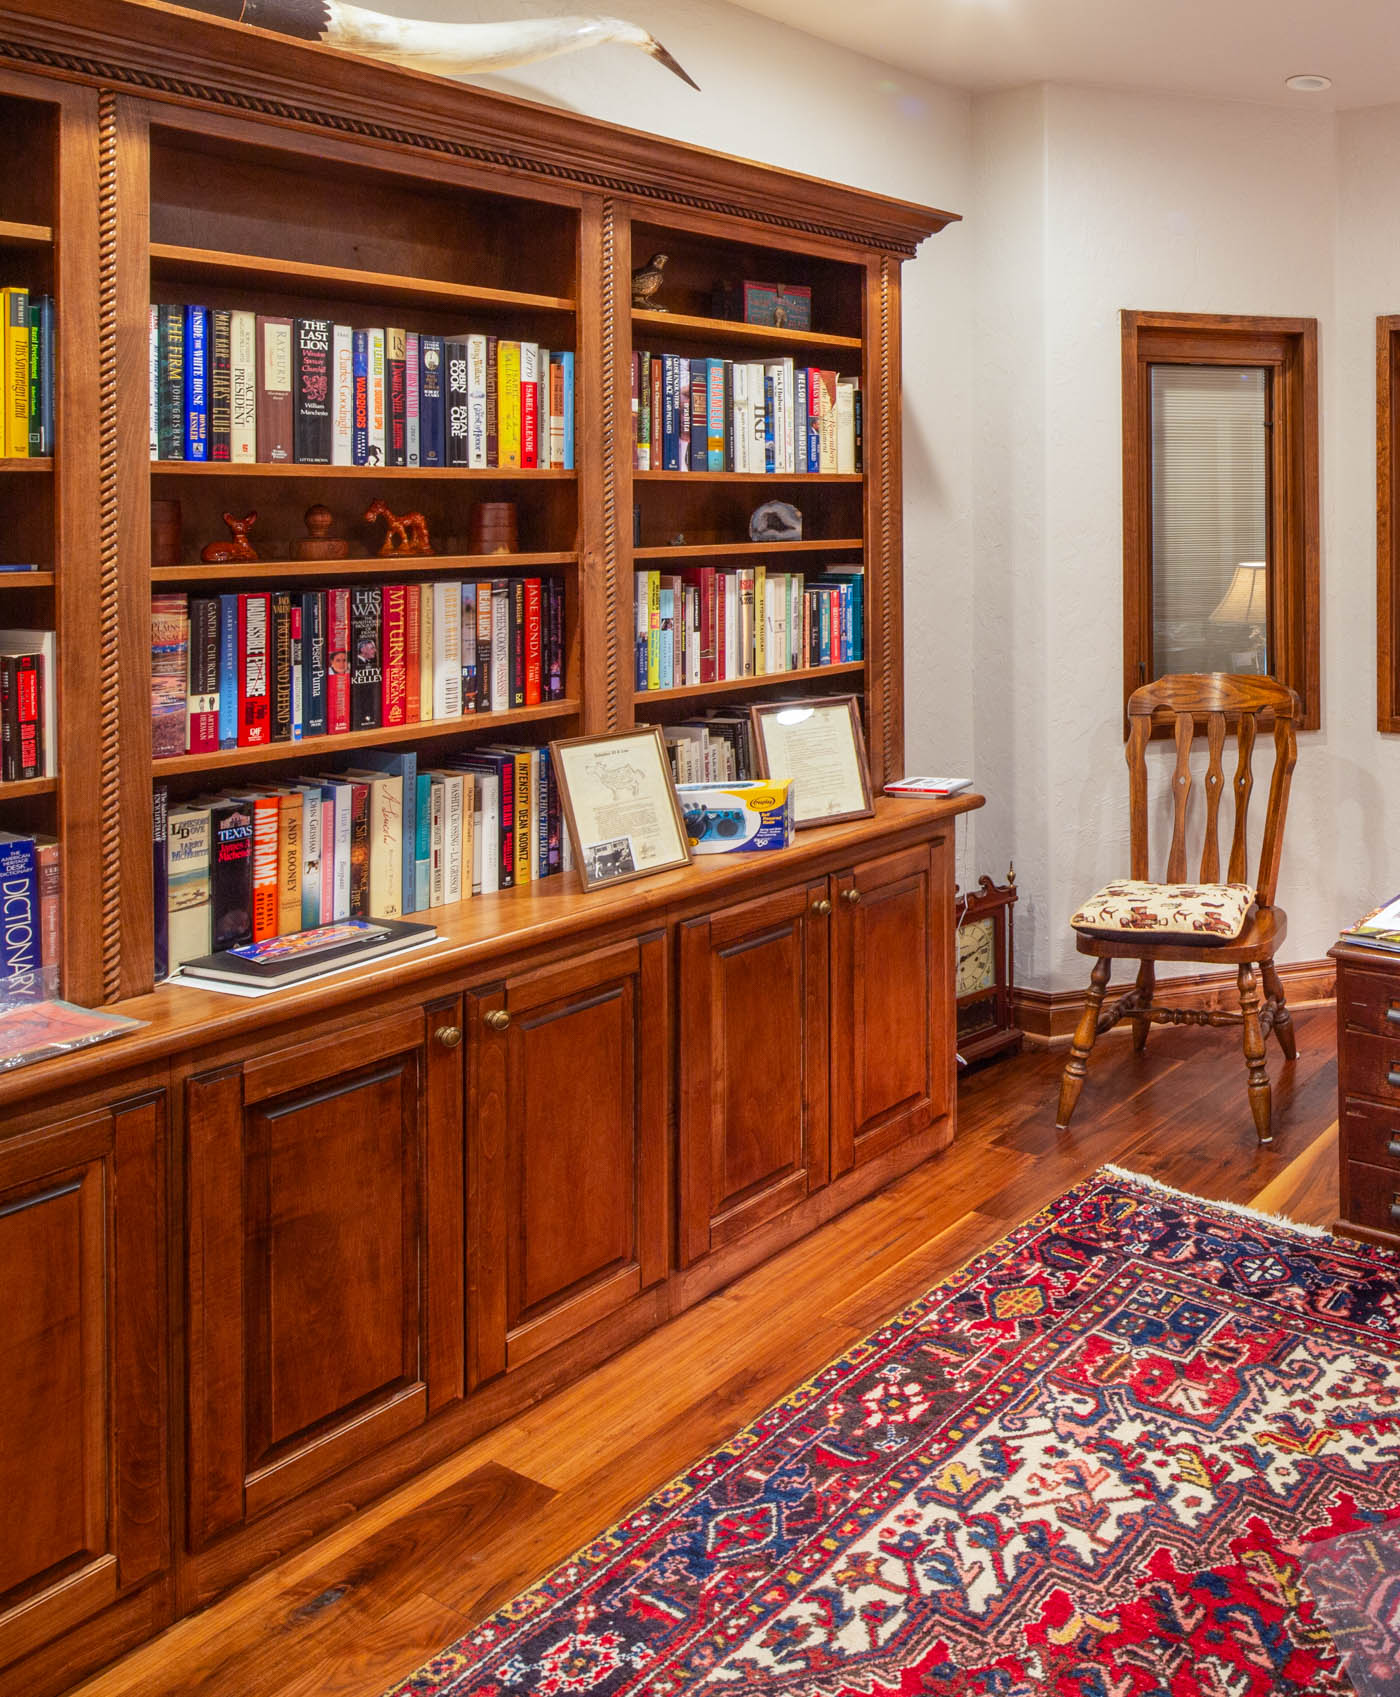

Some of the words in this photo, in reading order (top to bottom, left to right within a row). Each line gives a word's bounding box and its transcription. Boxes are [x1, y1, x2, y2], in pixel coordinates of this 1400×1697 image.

[168, 315, 182, 342] THE
[193, 312, 203, 339] INSIDE
[216, 314, 229, 336] MARY
[300, 330, 328, 341] LAST
[303, 321, 326, 331] THE
[216, 339, 229, 358] KARR
[300, 340, 328, 350] LION
[30, 344, 38, 379] Development
[168, 346, 182, 380] FIRM
[193, 350, 203, 376] WHITE
[339, 349, 350, 383] Charles
[450, 360, 459, 392] COOK
[458, 360, 467, 393] ROBIN
[526, 348, 536, 378] Zorro
[12, 358, 27, 396] Sovereign
[193, 378, 203, 405] HOUSE
[212, 370, 230, 403] LIARS'
[798, 373, 806, 403] NELSON
[15, 399, 27, 419] Land
[172, 384, 180, 406] JOHN
[235, 368, 245, 426] PRESIDENT
[246, 384, 254, 423] ACTING
[335, 385, 350, 435] Goodnight
[357, 377, 366, 428] WARRIORS
[710, 367, 723, 430] CARAMELO
[172, 409, 181, 447] GRISHAM
[190, 412, 198, 440] KESSLER
[212, 408, 230, 433] CLUB
[451, 407, 459, 436] CURE
[352, 604, 382, 616] WAY
[356, 591, 381, 604] HIS
[389, 590, 404, 614] MY
[479, 590, 490, 611] DEAD
[528, 584, 539, 613] JANE
[207, 602, 217, 638] GANDHI
[246, 598, 266, 655] INADMISSIBLE
[479, 614, 490, 641] LUCKY
[496, 598, 506, 632] STEPHEN
[312, 637, 324, 667] Desert
[389, 620, 404, 666] TURN
[496, 632, 506, 661] COONTS
[530, 617, 539, 658] FONDA
[207, 644, 217, 693] CHURCHILL
[246, 656, 265, 697] EVIDENCE
[312, 670, 324, 696] Puma
[351, 675, 382, 684] KELLEY
[355, 668, 381, 676] KITTY
[390, 668, 399, 704] REAGAN
[277, 684, 289, 723] DEFEND
[451, 782, 460, 813] WASHITA
[519, 763, 528, 805] INTENSITY
[308, 797, 319, 818] JOHN
[539, 780, 547, 820] TOUCHING
[218, 825, 253, 842] TEXAS
[288, 817, 296, 846] ANDY
[451, 813, 460, 846] CROSSING
[519, 809, 528, 829] DEAN
[180, 840, 203, 850] LARRY
[254, 808, 279, 887] AIRFRAME
[309, 819, 318, 854] GRISHAM
[519, 832, 528, 861] KOONTZ
[288, 850, 297, 892] ROONEY
[360, 861, 369, 892] PRINCE
[450, 865, 459, 894] GRISSOM
[256, 893, 265, 931] CRICHTON
[3, 878, 35, 995] DICTIONARY
